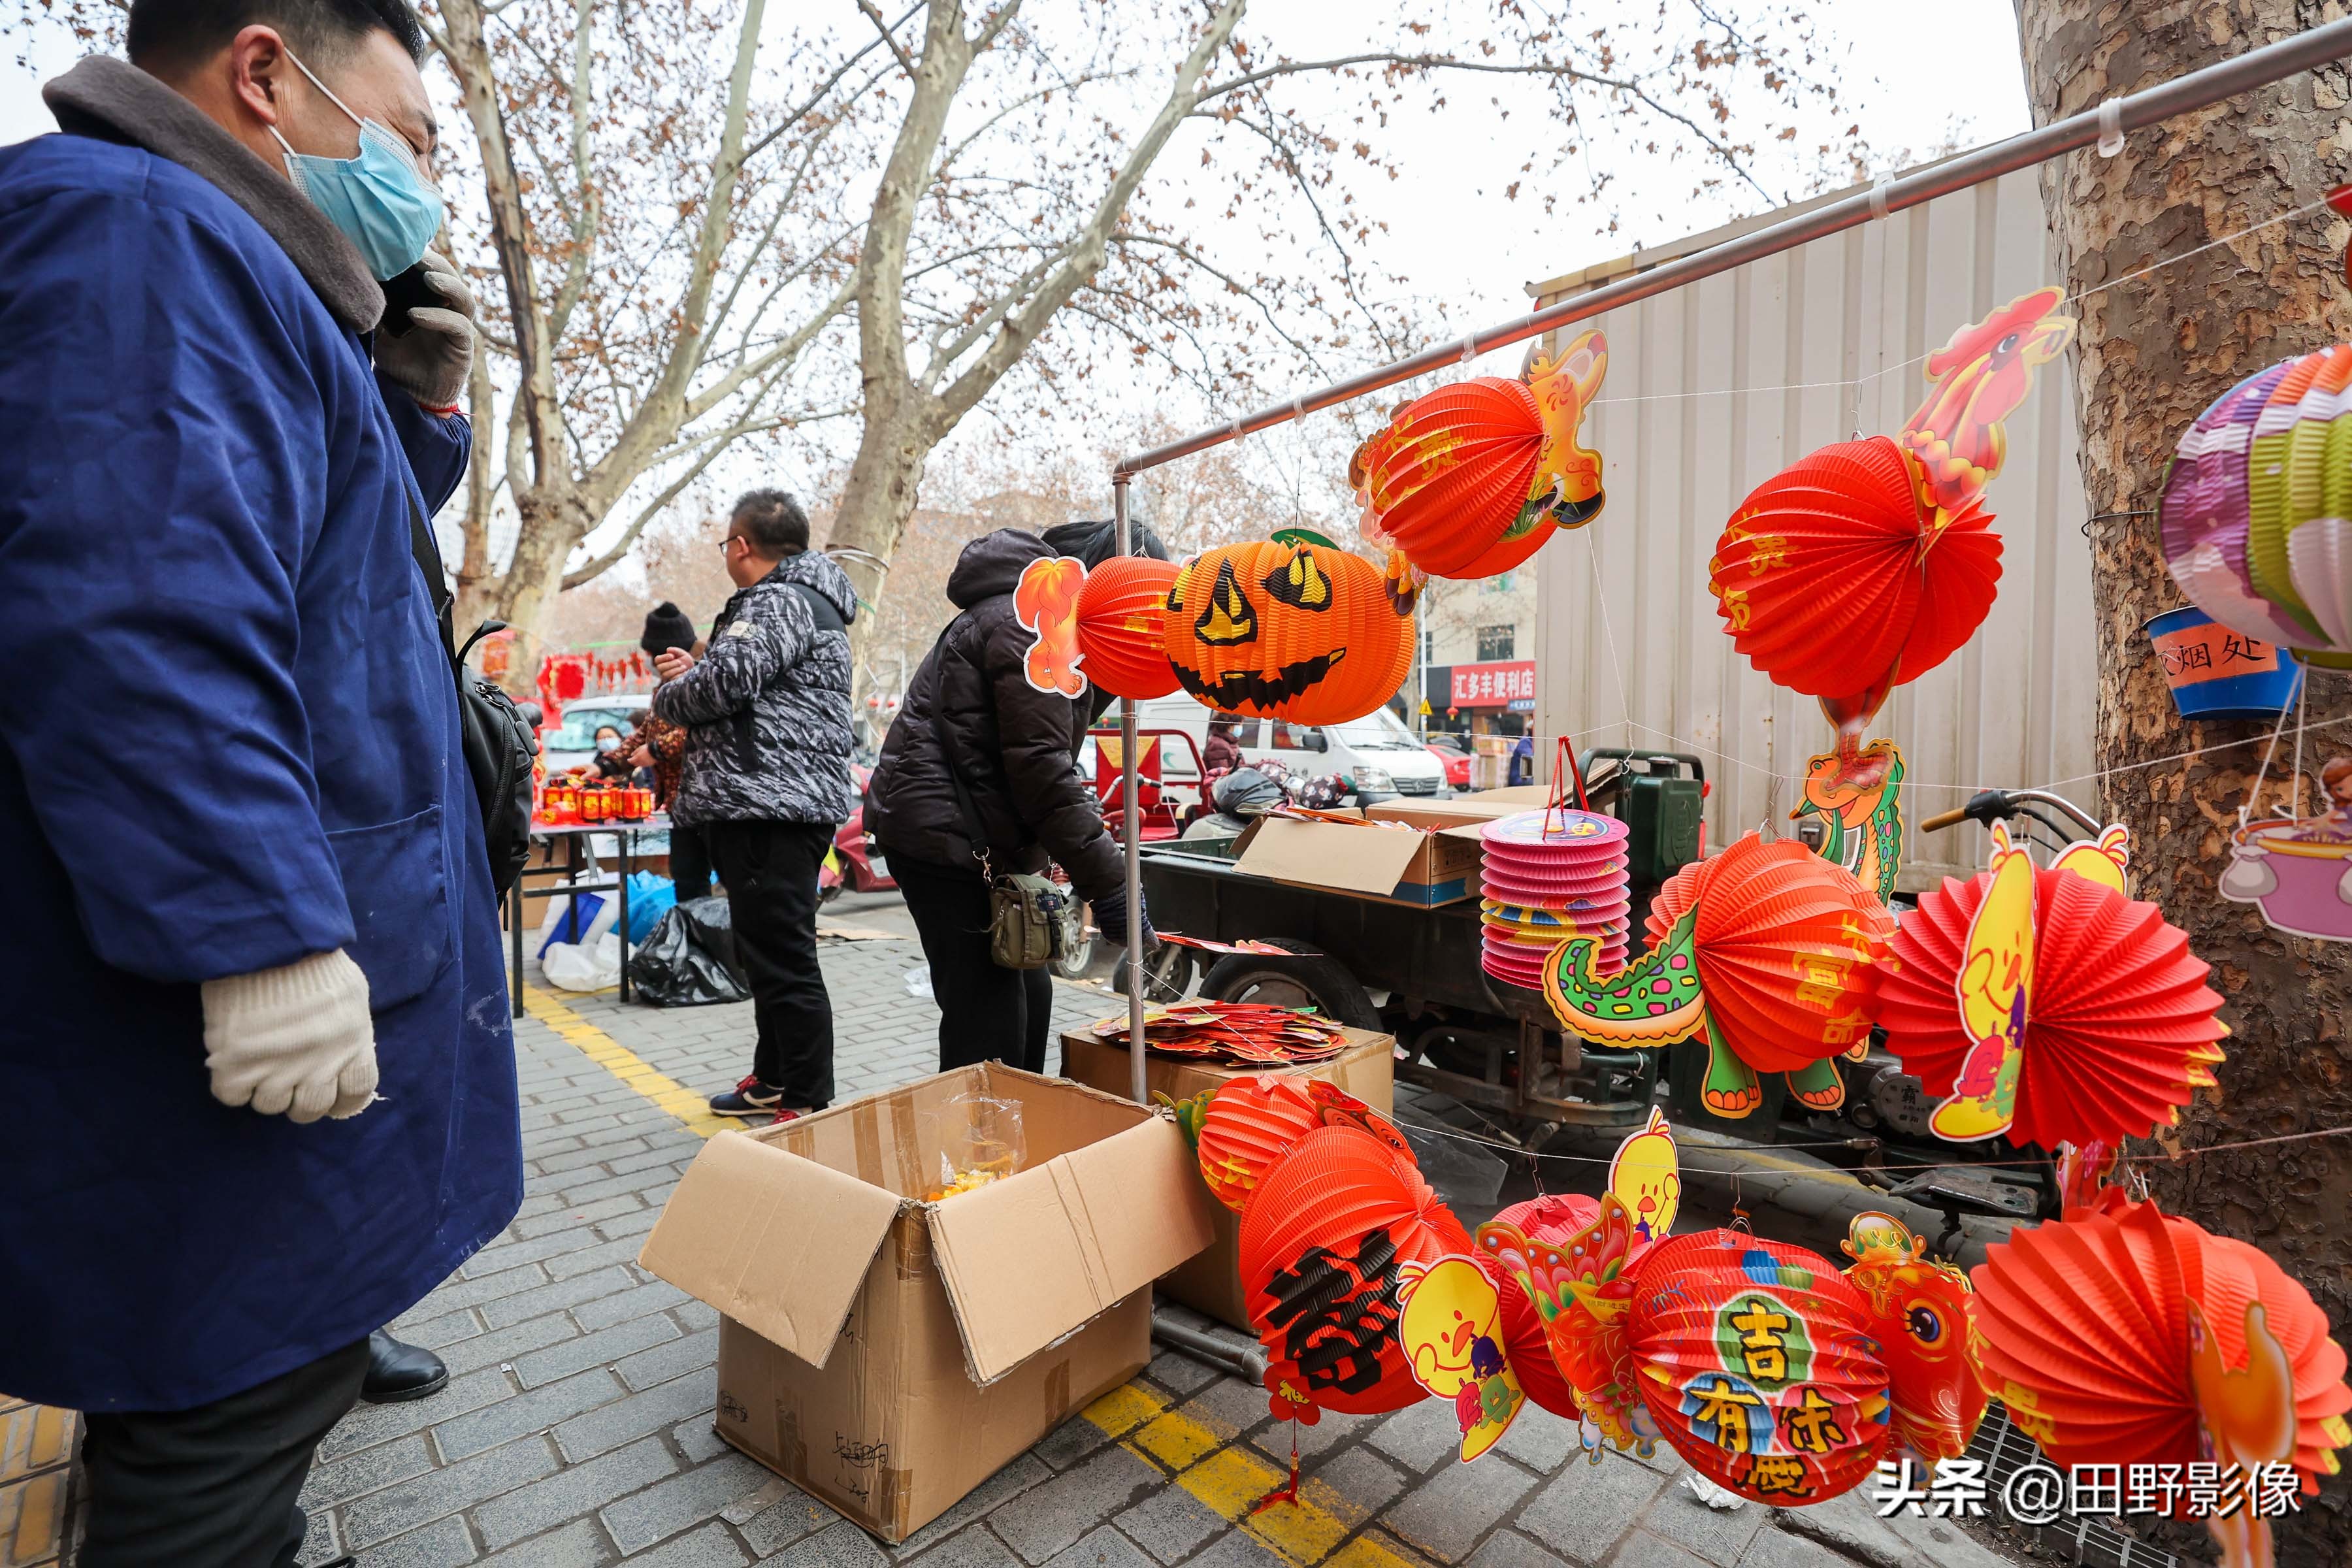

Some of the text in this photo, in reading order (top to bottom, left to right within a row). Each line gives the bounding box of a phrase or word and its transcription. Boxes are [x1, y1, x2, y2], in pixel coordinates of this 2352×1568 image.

[1454, 668, 1534, 700] 汇多丰便利店
[1728, 1298, 1792, 1383] 吉
[1688, 1377, 1763, 1454] 有
